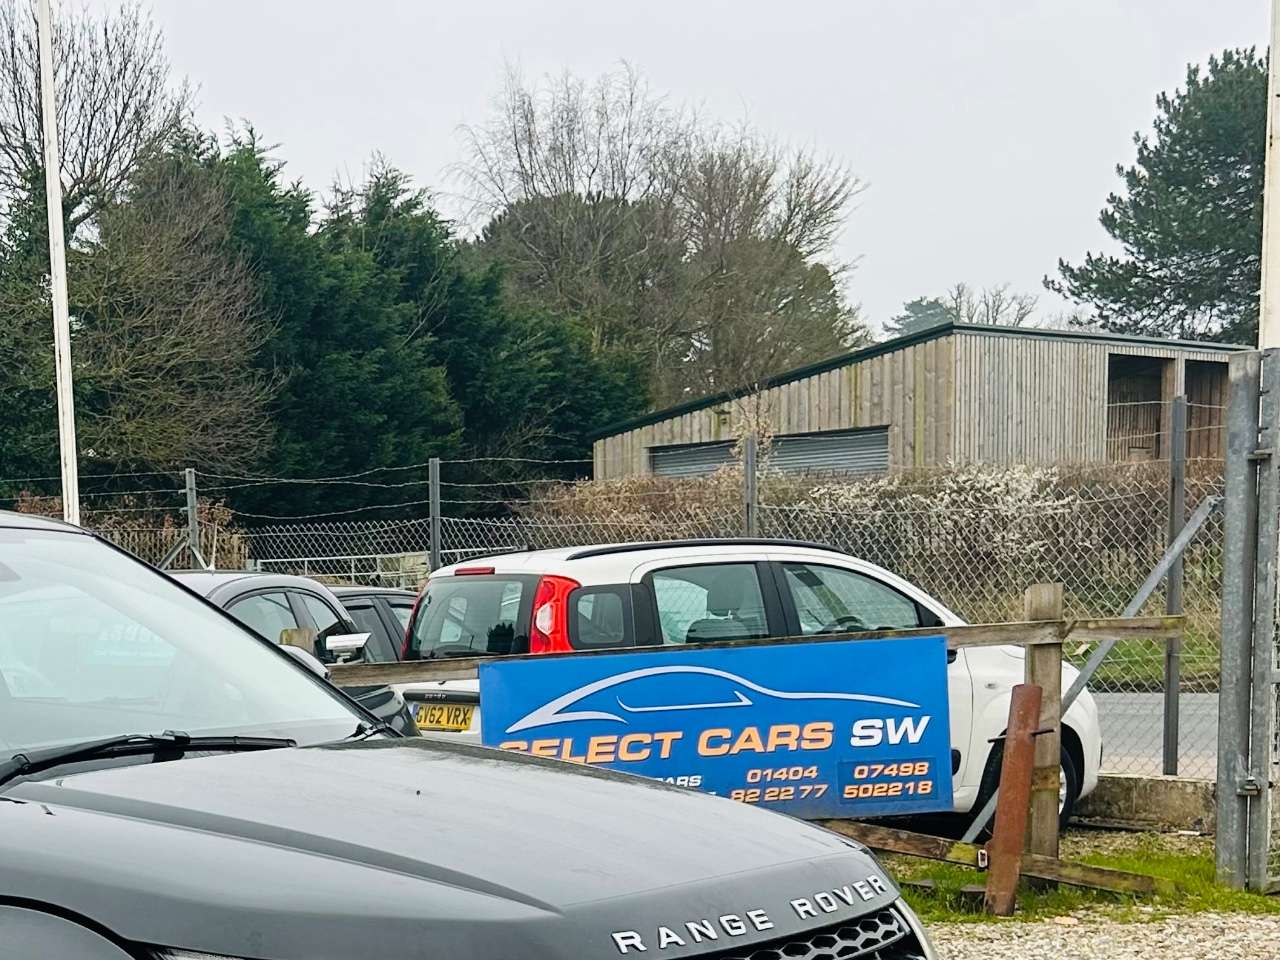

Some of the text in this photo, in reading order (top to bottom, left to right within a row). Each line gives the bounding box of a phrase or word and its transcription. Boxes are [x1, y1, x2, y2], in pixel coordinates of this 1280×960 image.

[447, 707, 470, 726] VRX
[697, 722, 834, 757] CARS
[850, 716, 930, 747] SW
[746, 766, 819, 783] 01404
[853, 762, 930, 779] 07498
[843, 781, 933, 799] 502218
[611, 874, 887, 954] RANGE ROVER
